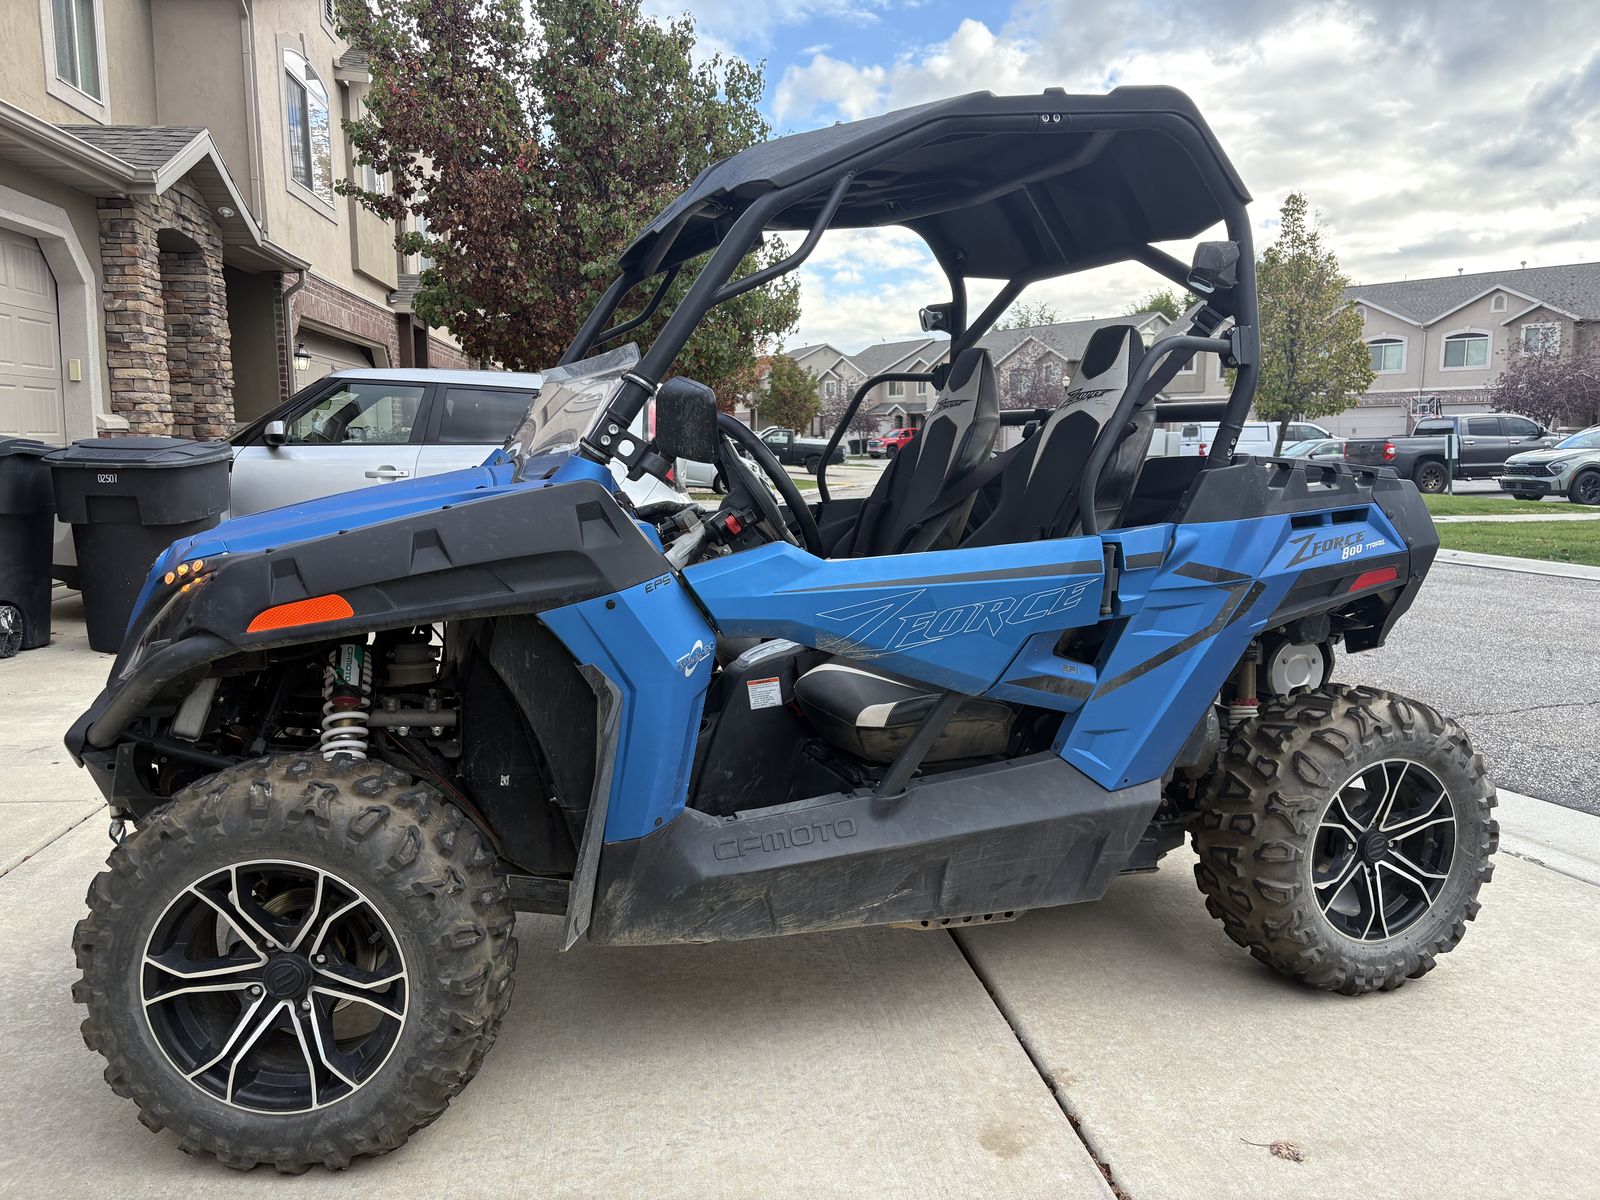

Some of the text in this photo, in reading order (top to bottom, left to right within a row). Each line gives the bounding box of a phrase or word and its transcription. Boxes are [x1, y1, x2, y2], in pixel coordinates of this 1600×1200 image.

[1342, 544, 1363, 560] 800
[644, 575, 671, 594] EPS
[344, 646, 354, 682] CFMOTO
[713, 817, 858, 861] CFMOTO
